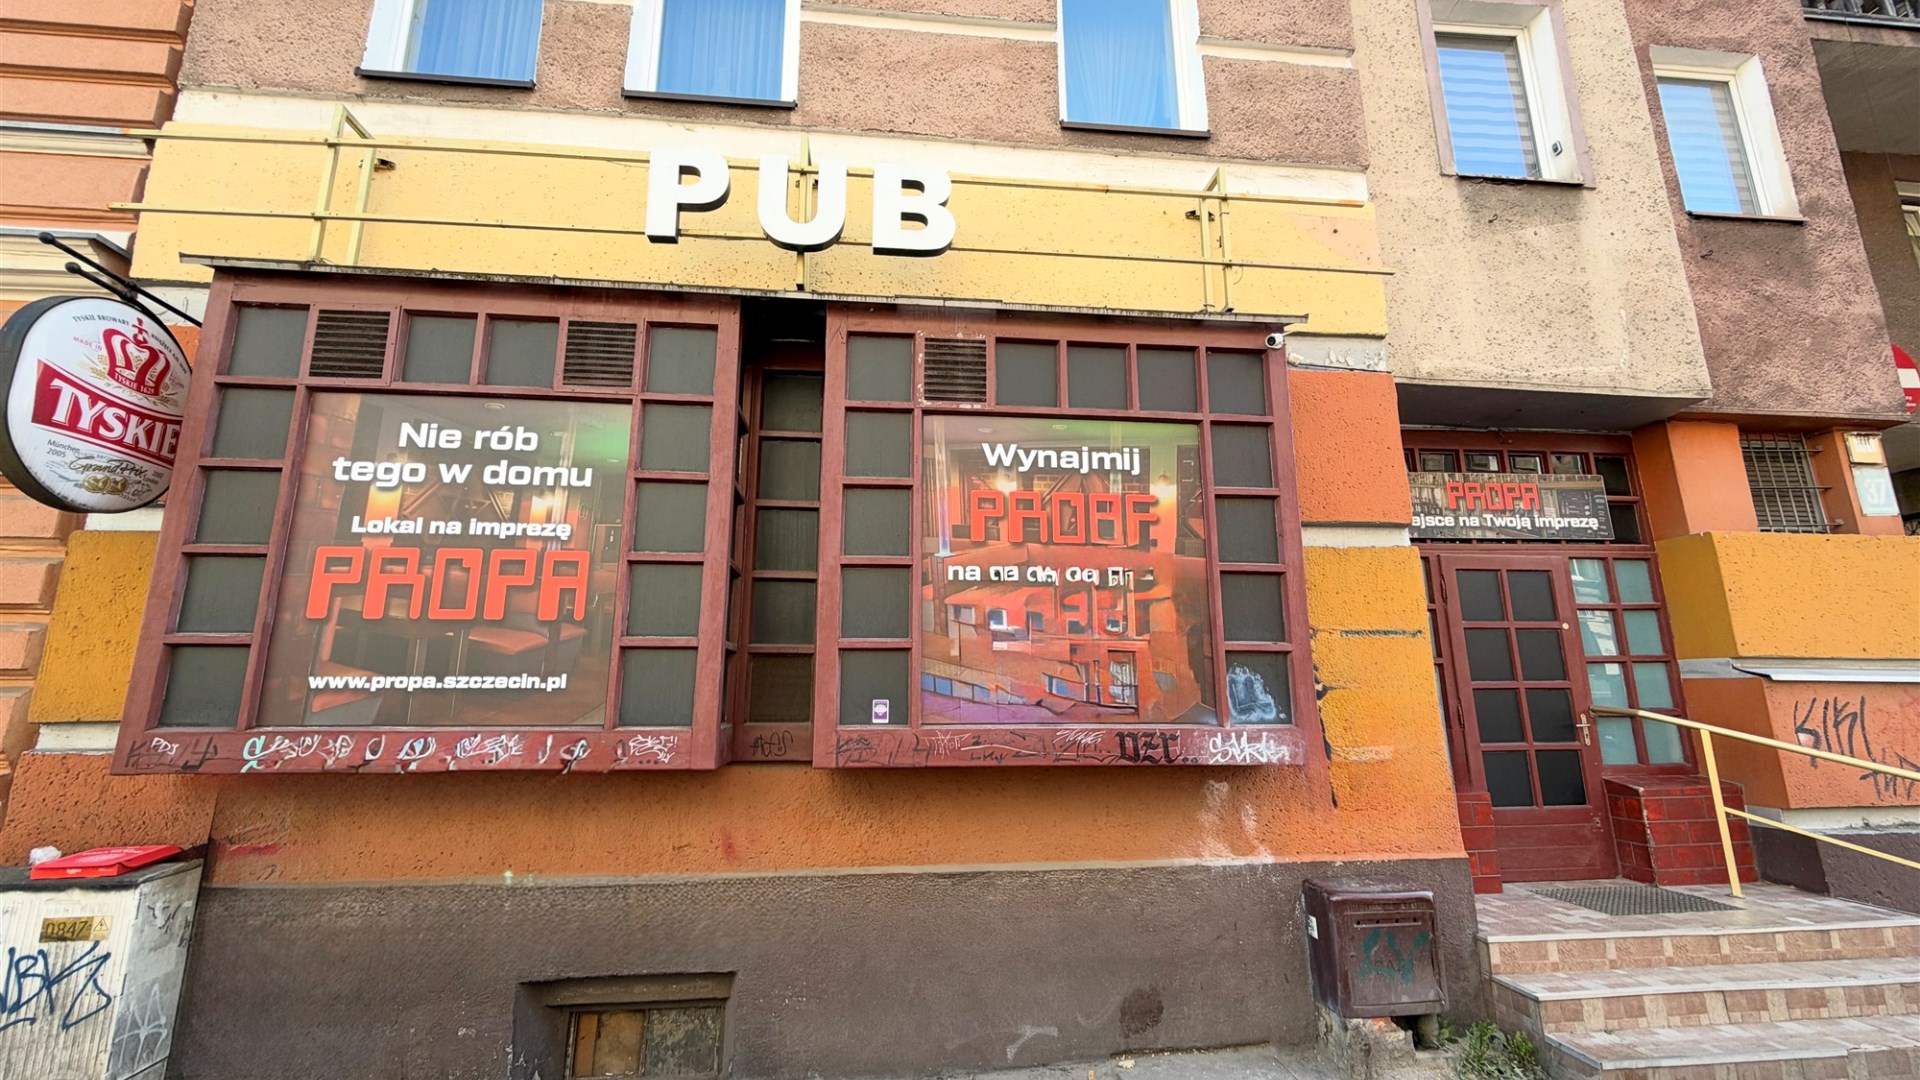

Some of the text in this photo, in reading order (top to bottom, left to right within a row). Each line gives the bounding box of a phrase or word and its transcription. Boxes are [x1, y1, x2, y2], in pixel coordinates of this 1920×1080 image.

[645, 148, 956, 257] PUB
[73, 336, 103, 352] MADE IN
[114, 373, 139, 390] TYSKIE
[50, 377, 181, 457] TYSKIE
[47, 439, 80, 454] München
[398, 422, 538, 452] Nie rób
[47, 447, 67, 458] 2005
[68, 454, 120, 475] Grand
[982, 442, 1141, 476] Wynajmij
[333, 456, 593, 488] tego w domu
[1446, 482, 1541, 511] PROPA
[1864, 479, 1887, 504] 37
[351, 515, 572, 541] Lokal na imprezę
[1459, 516, 1480, 527] na
[1482, 514, 1532, 530] Twoją
[1535, 514, 1599, 530] imprezę
[306, 546, 590, 621] PROPA
[947, 565, 981, 581] na
[308, 673, 567, 691] www.propa.szczecin.pl
